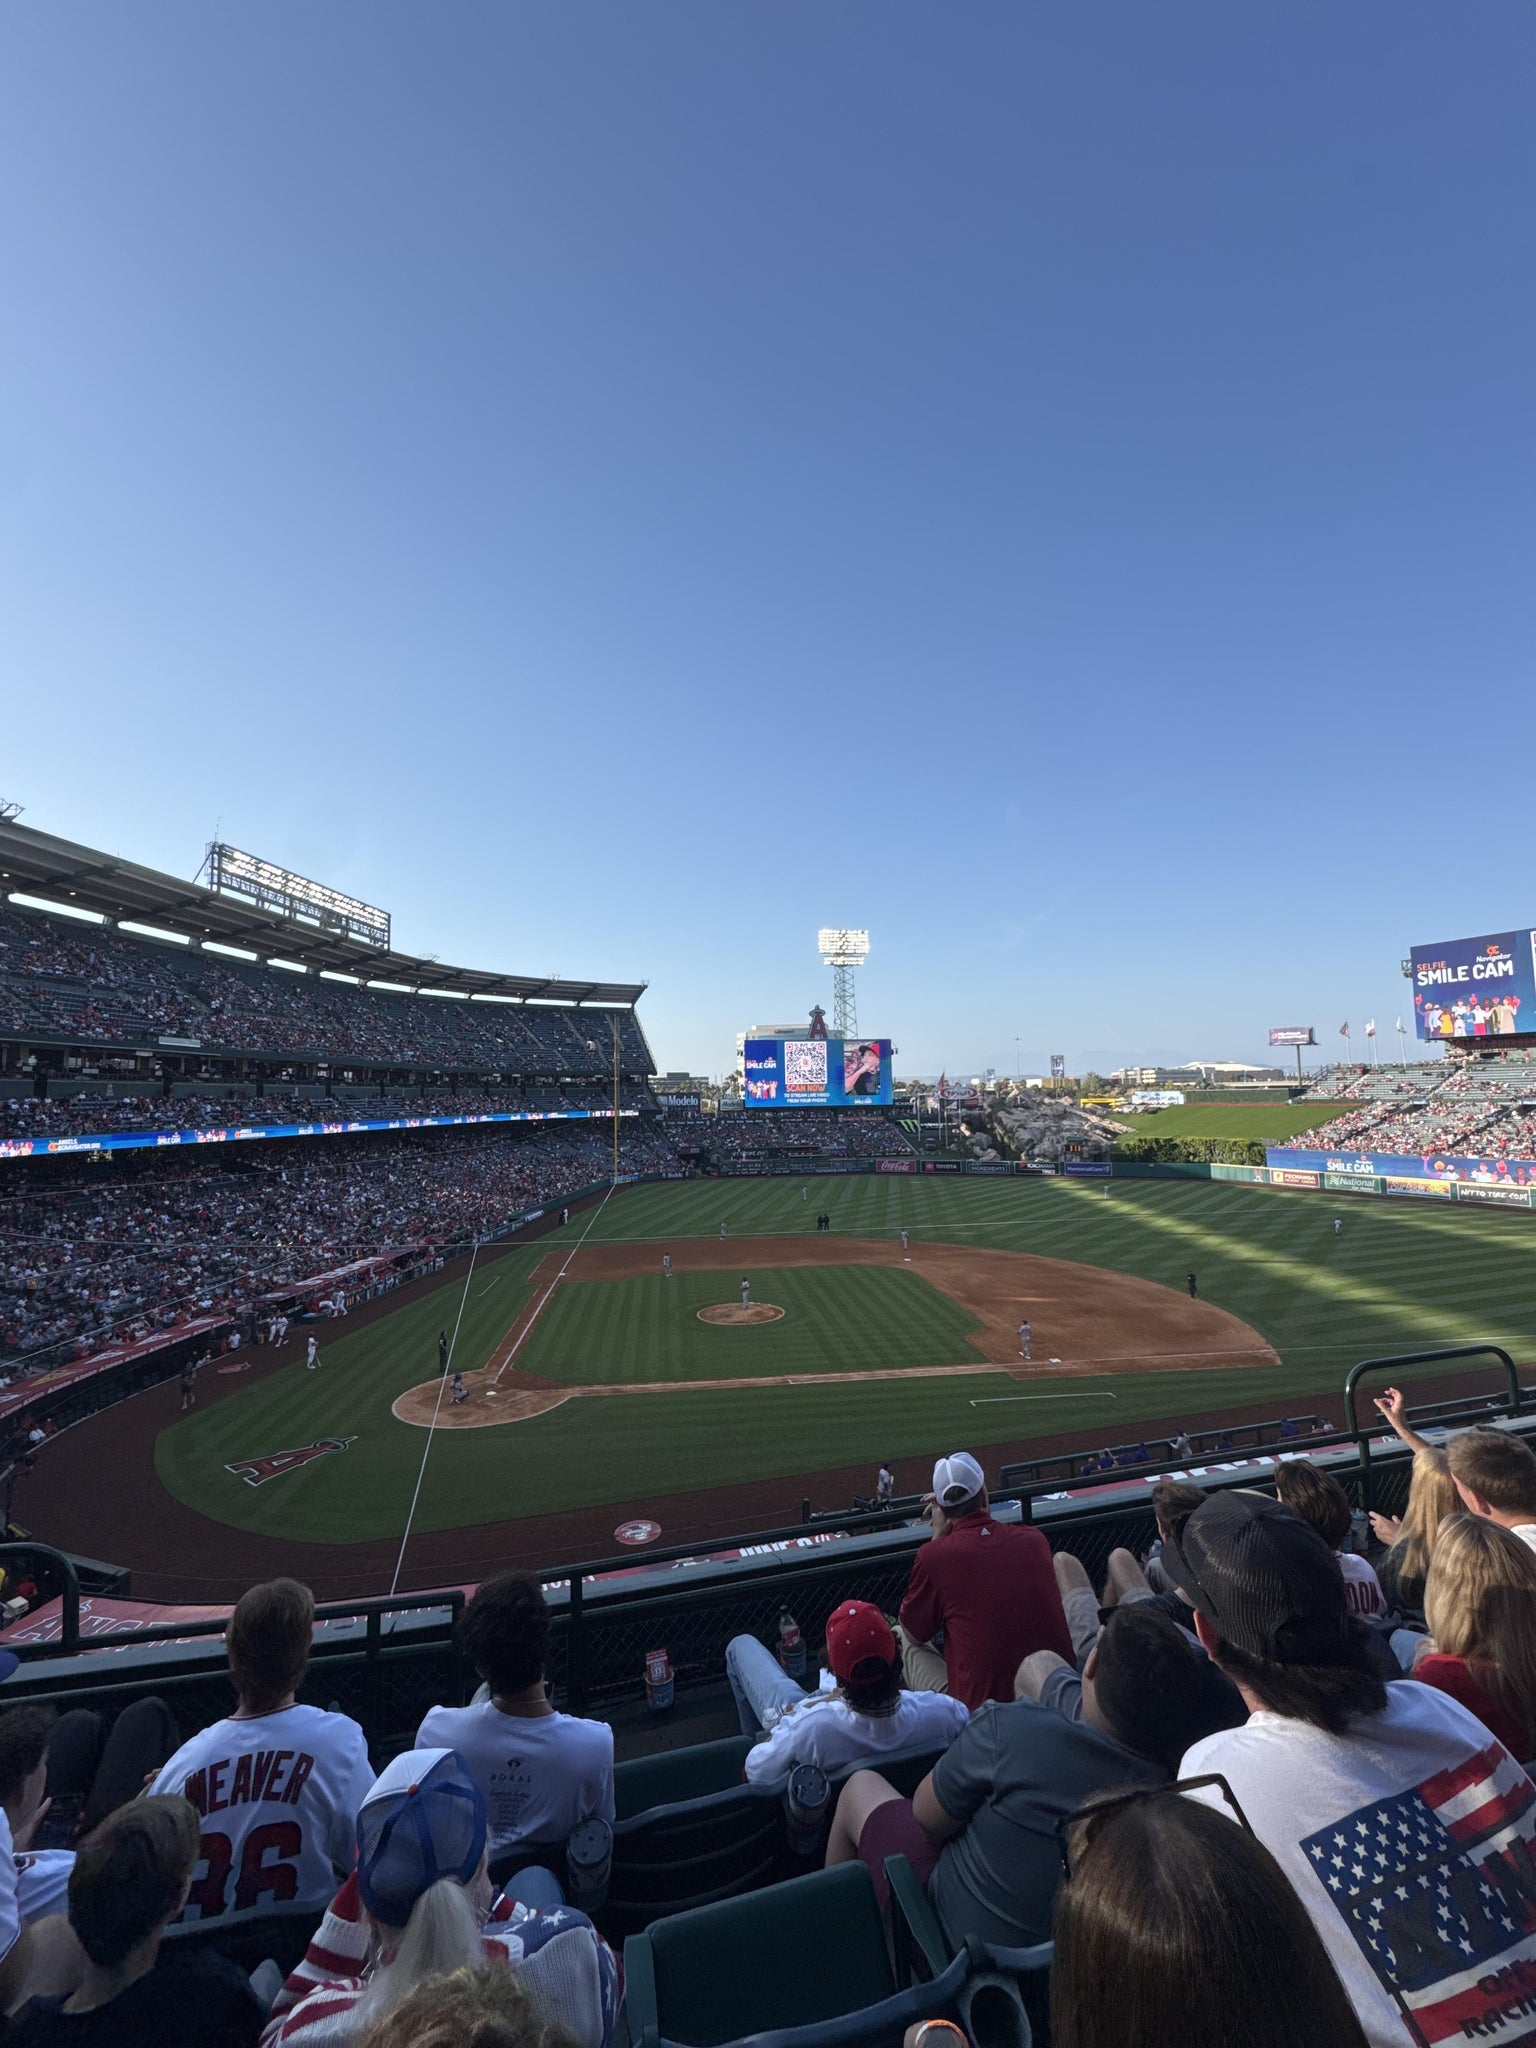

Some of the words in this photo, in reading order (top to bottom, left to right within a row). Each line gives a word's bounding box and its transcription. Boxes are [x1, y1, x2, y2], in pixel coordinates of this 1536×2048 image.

[1476, 953, 1512, 963] Navigator
[1417, 960, 1447, 972] SELFIE
[1417, 965, 1470, 986] SMILE
[1472, 960, 1514, 980] CAM
[746, 1061, 763, 1069] SMILE
[764, 1060, 777, 1069] CAM
[786, 1084, 805, 1093] SCAN
[807, 1084, 825, 1092] NOW
[668, 1095, 698, 1106] Modelo
[1327, 1162, 1353, 1172] SMILE
[1354, 1163, 1374, 1173] CAM
[1340, 1176, 1375, 1188] National
[1460, 1188, 1486, 1197] NITTO
[184, 1750, 315, 1817] WEAVER
